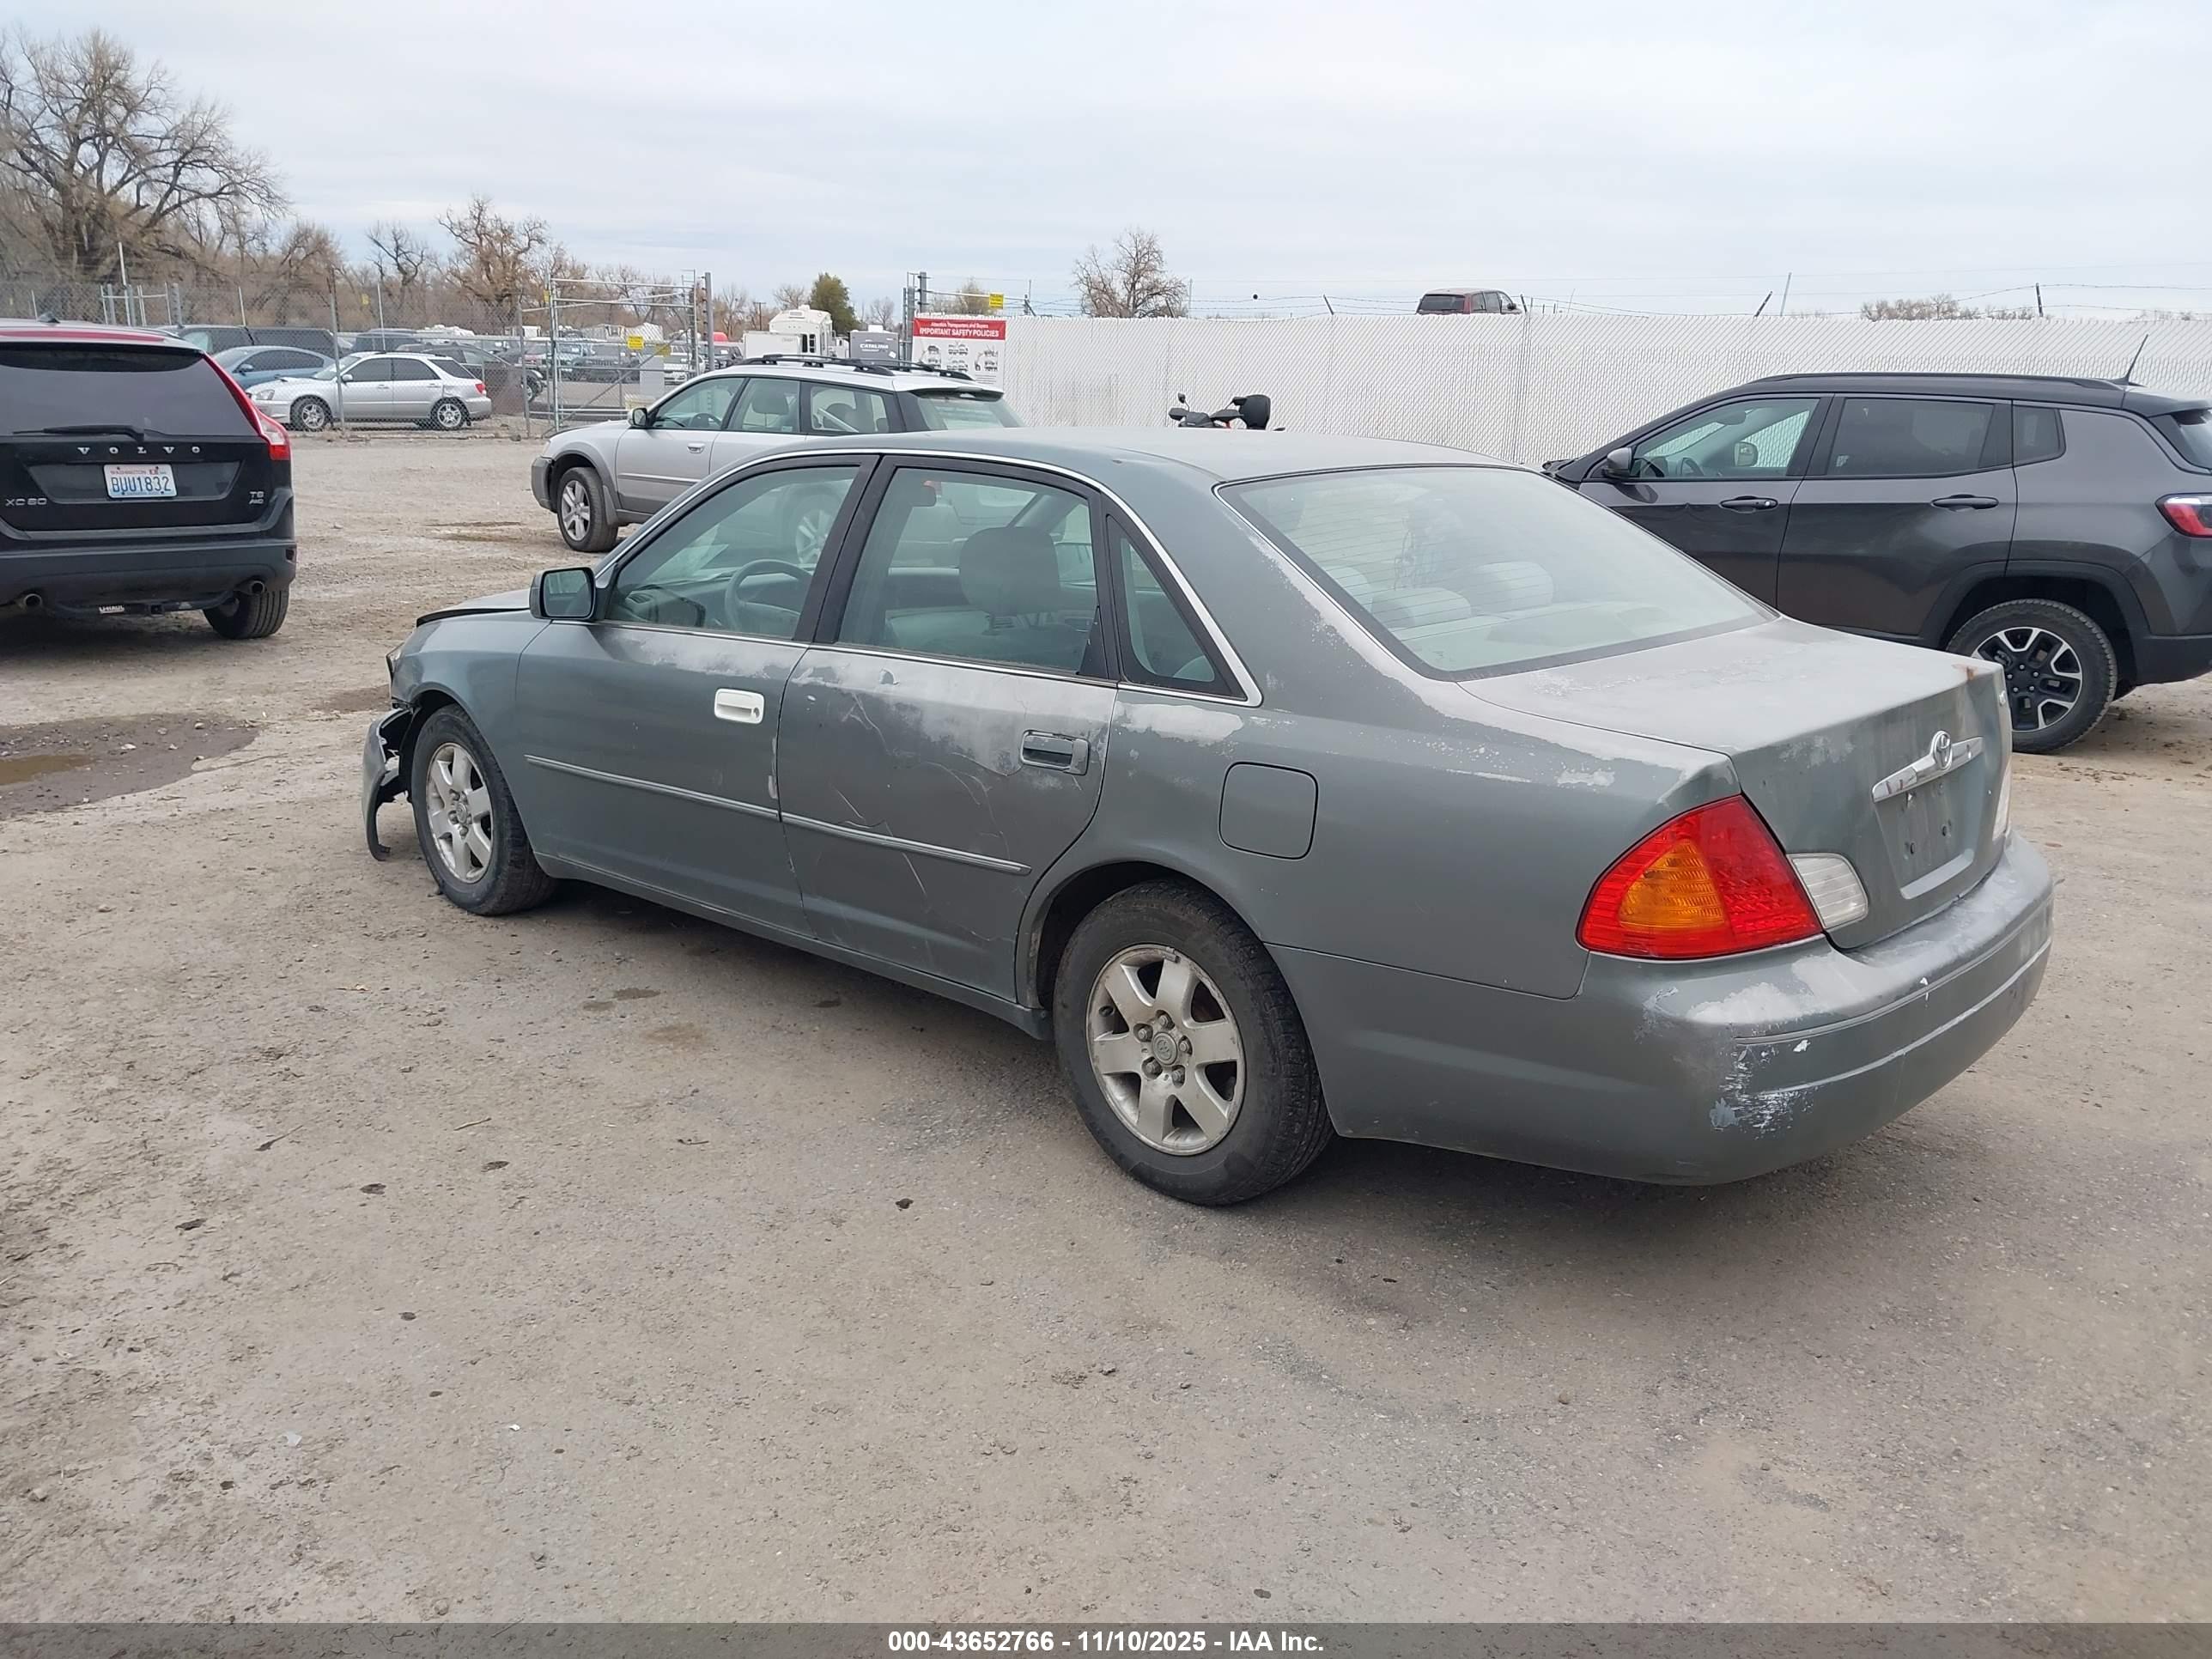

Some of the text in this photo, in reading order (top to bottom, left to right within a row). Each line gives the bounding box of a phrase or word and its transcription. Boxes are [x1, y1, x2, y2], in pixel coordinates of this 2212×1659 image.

[920, 327, 1000, 337] IMPORTANT SAFETY POLICIES
[77, 446, 201, 454] VOLVO
[111, 476, 172, 493] BUU1832
